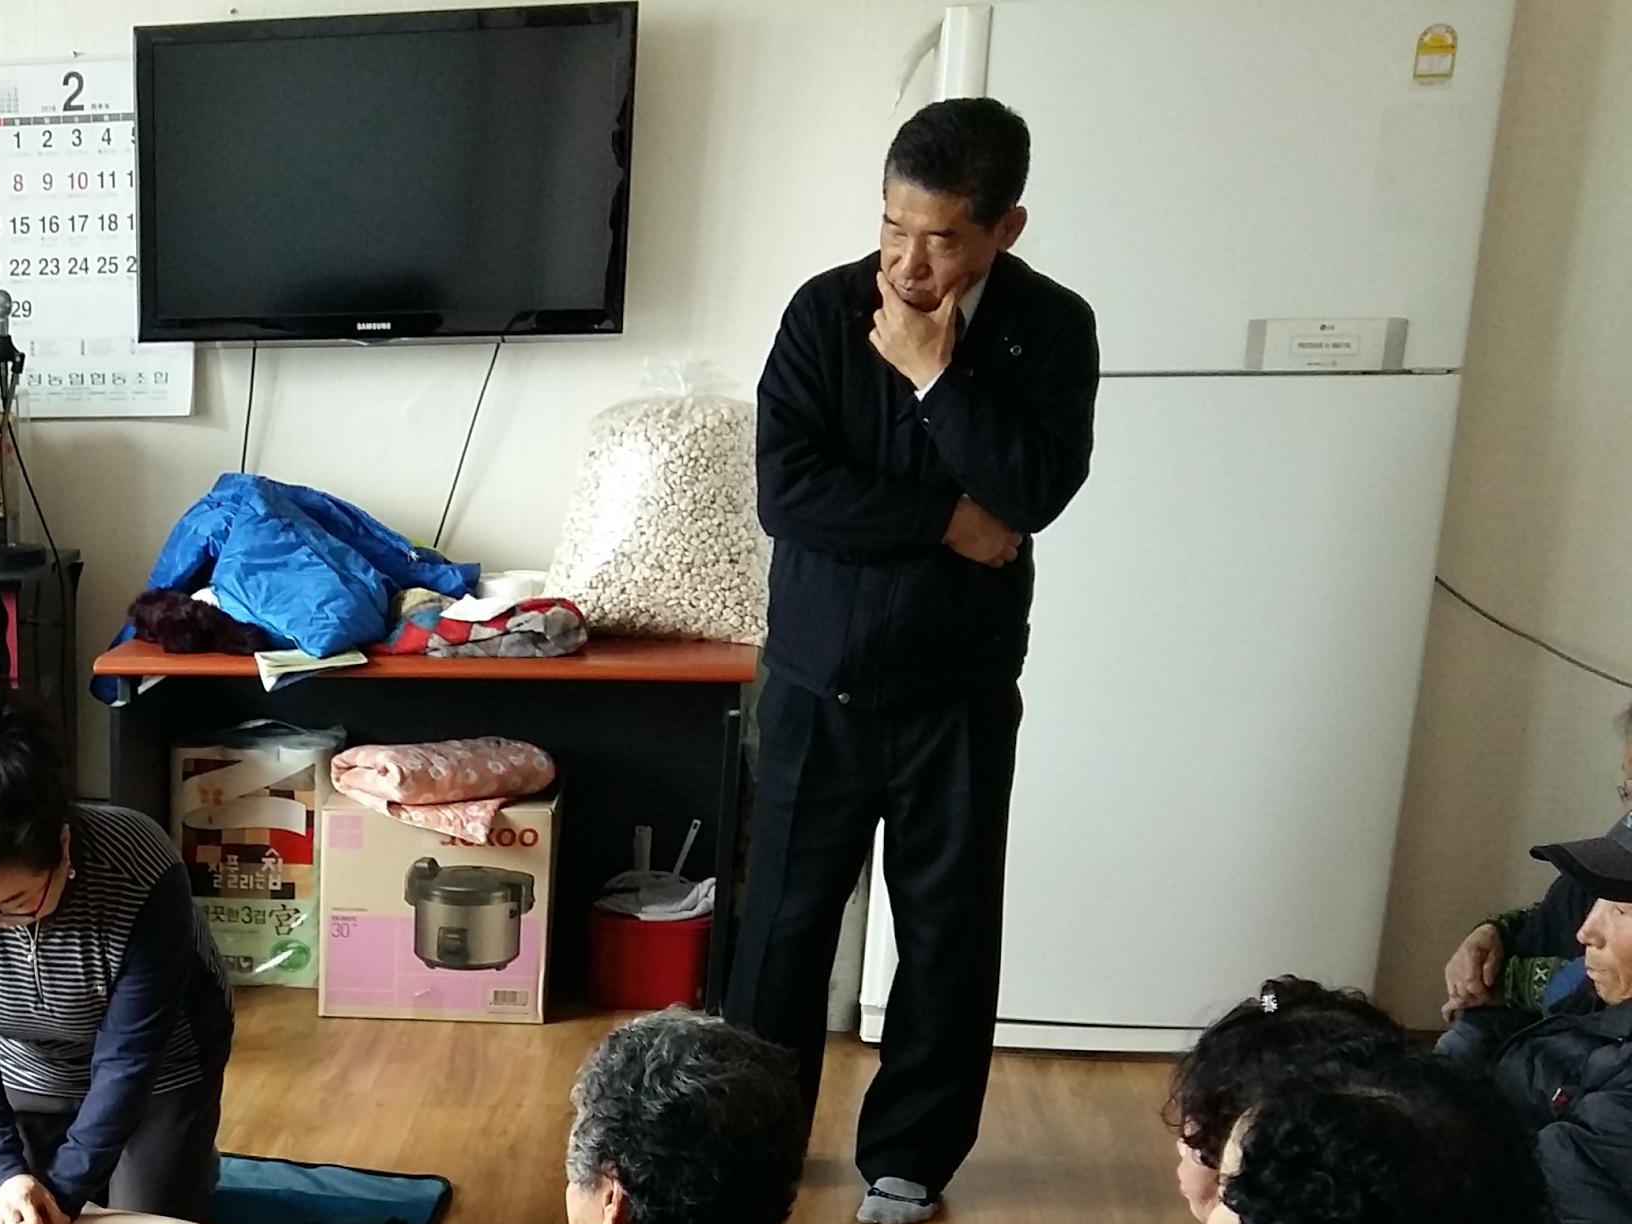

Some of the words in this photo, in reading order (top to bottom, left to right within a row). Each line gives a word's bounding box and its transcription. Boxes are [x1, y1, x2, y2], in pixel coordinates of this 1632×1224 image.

[62, 71, 85, 112] 2
[13, 131, 21, 149] 1
[42, 130, 53, 148] 2
[71, 128, 82, 147] 3
[101, 127, 112, 146] 4
[13, 174, 24, 192] 8
[42, 173, 53, 191] 9
[68, 171, 88, 190] 10
[97, 170, 116, 189] 11
[9, 216, 30, 235] 15
[38, 215, 60, 234] 16
[68, 214, 89, 233] 17
[97, 213, 118, 232] 18
[9, 258, 31, 276] 22
[38, 257, 60, 275] 23
[68, 257, 89, 275] 24
[97, 255, 118, 274] 25
[126, 255, 137, 273] 2
[11, 300, 32, 318] 29
[356, 322, 392, 331] SAMSUNG
[331, 922, 350, 938] 30
